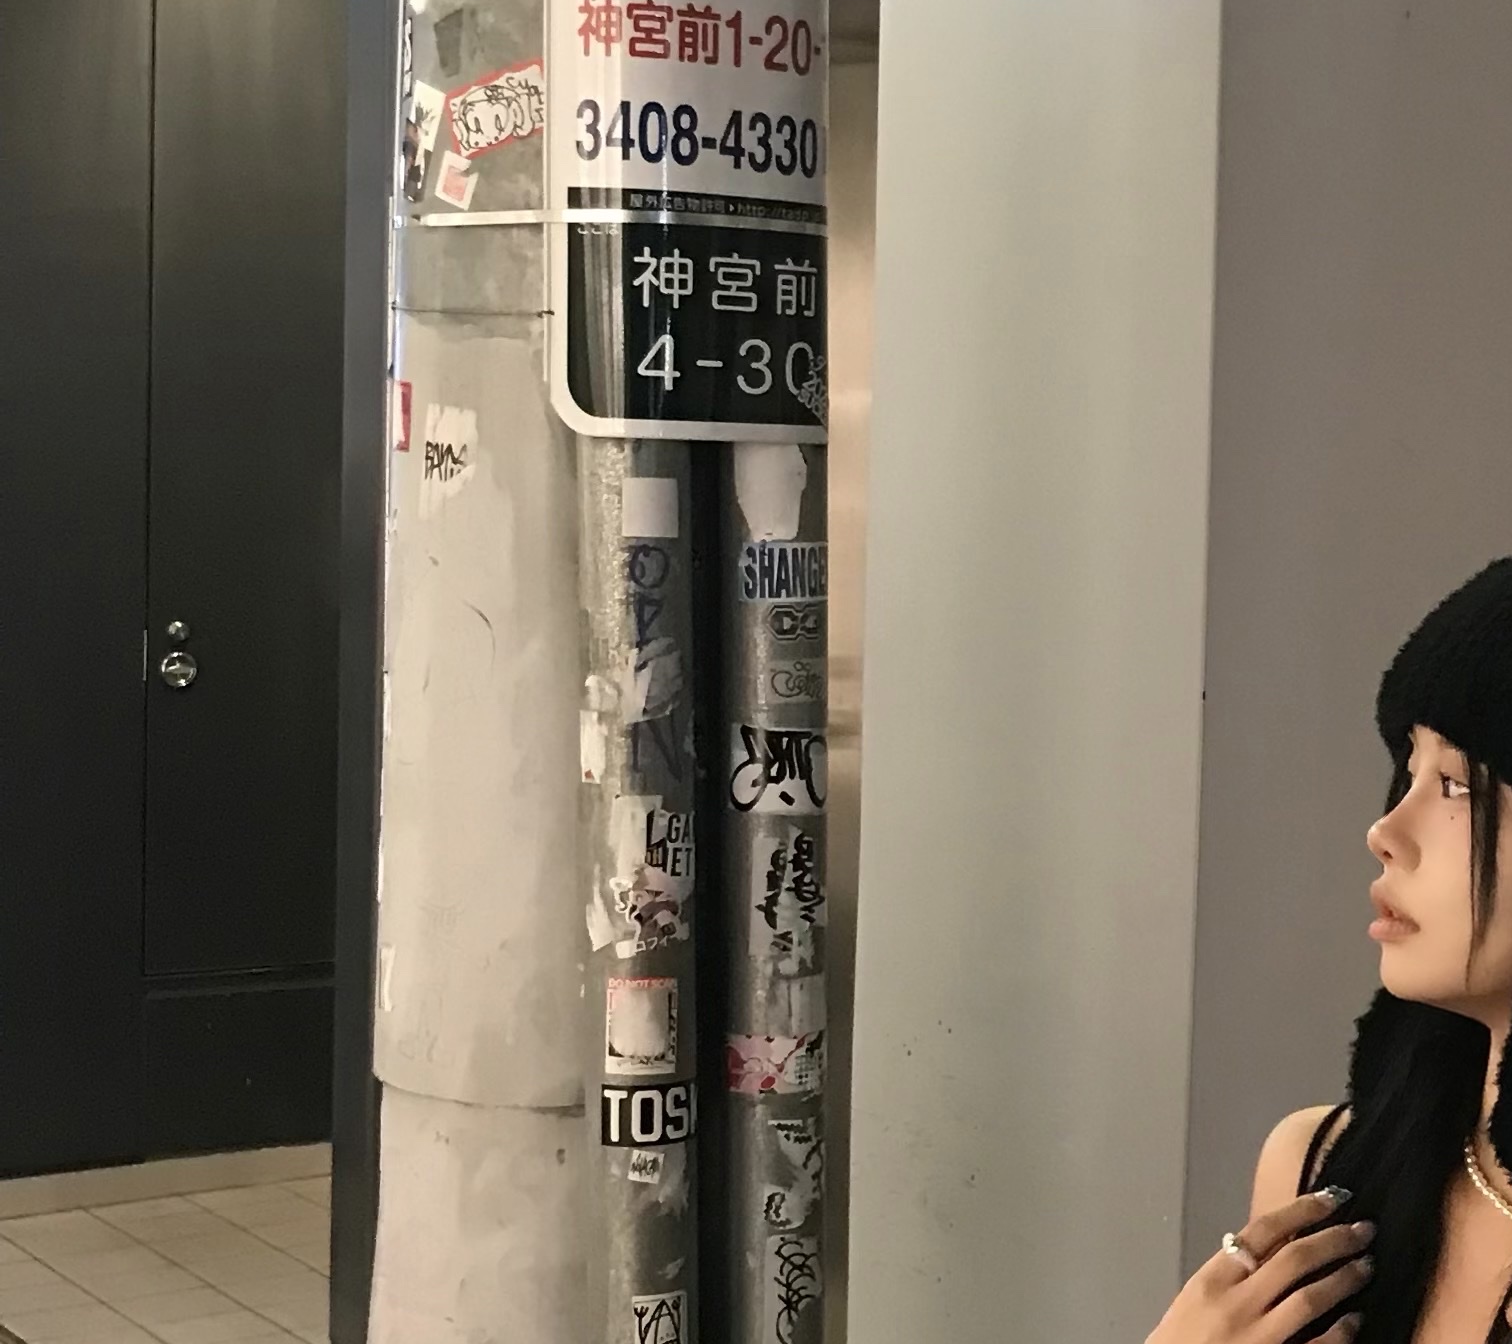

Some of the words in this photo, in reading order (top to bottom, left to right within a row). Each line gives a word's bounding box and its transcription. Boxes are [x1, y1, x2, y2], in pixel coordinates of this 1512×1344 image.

[576, 99, 818, 179] 3408-4330
[632, 247, 819, 318] 神宮前
